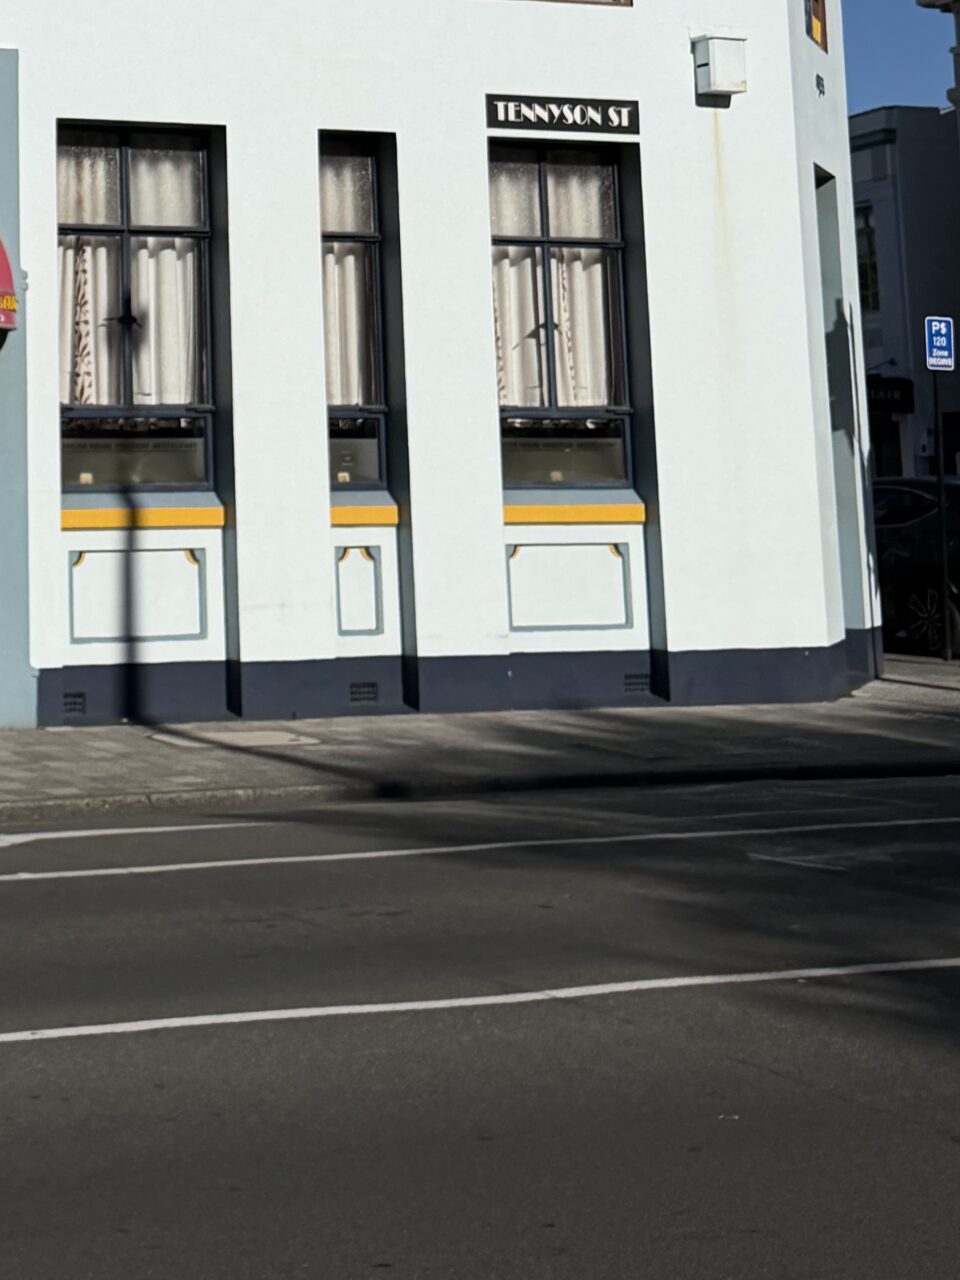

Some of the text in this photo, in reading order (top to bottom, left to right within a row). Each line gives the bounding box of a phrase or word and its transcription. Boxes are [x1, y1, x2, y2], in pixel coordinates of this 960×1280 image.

[493, 101, 632, 128] TENNYSON ST
[933, 336, 947, 347] 120
[932, 348, 949, 357] Zone
